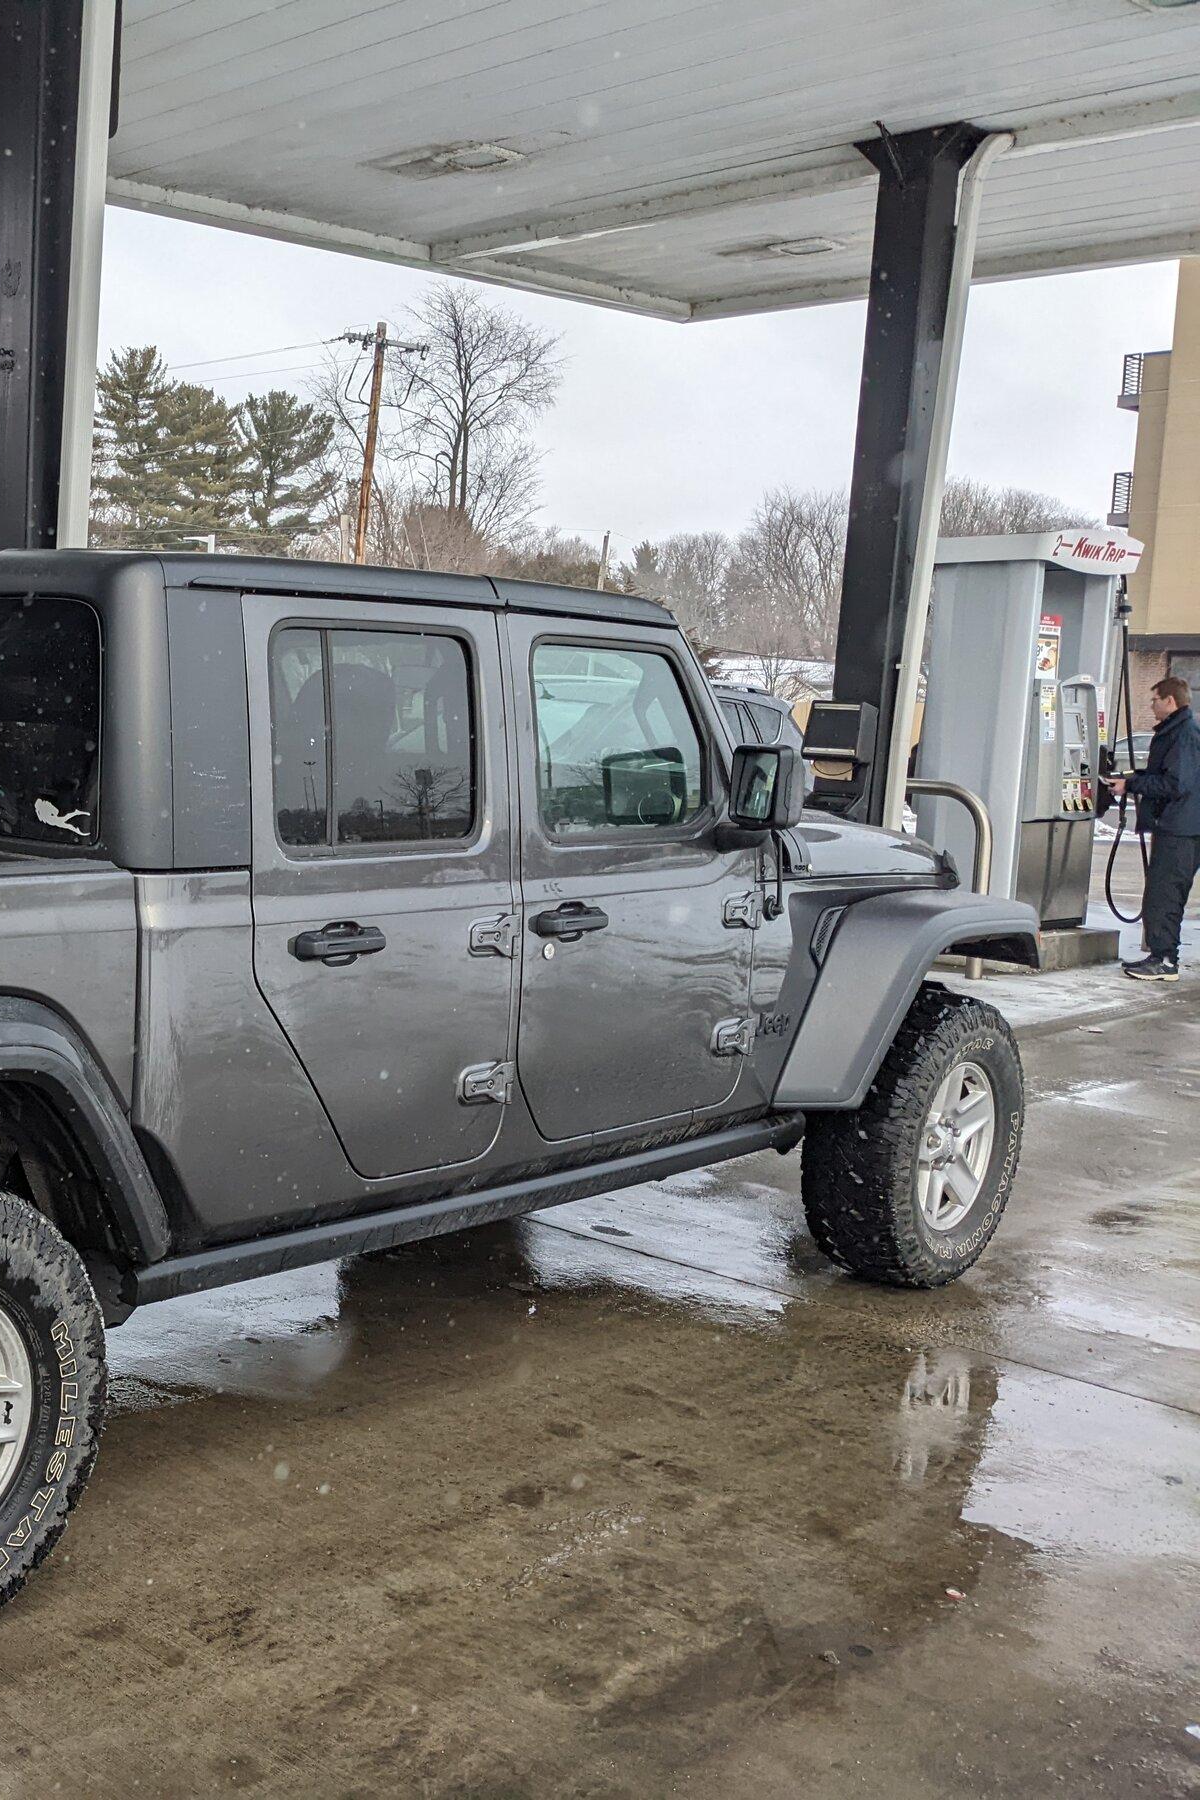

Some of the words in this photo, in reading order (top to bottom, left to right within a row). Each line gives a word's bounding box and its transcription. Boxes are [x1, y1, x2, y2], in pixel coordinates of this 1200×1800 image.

[1052, 534, 1063, 557] 2
[1072, 536, 1105, 561] KWIK
[1102, 540, 1126, 563] TRIP
[956, 1112, 1020, 1257] PATAGONIA
